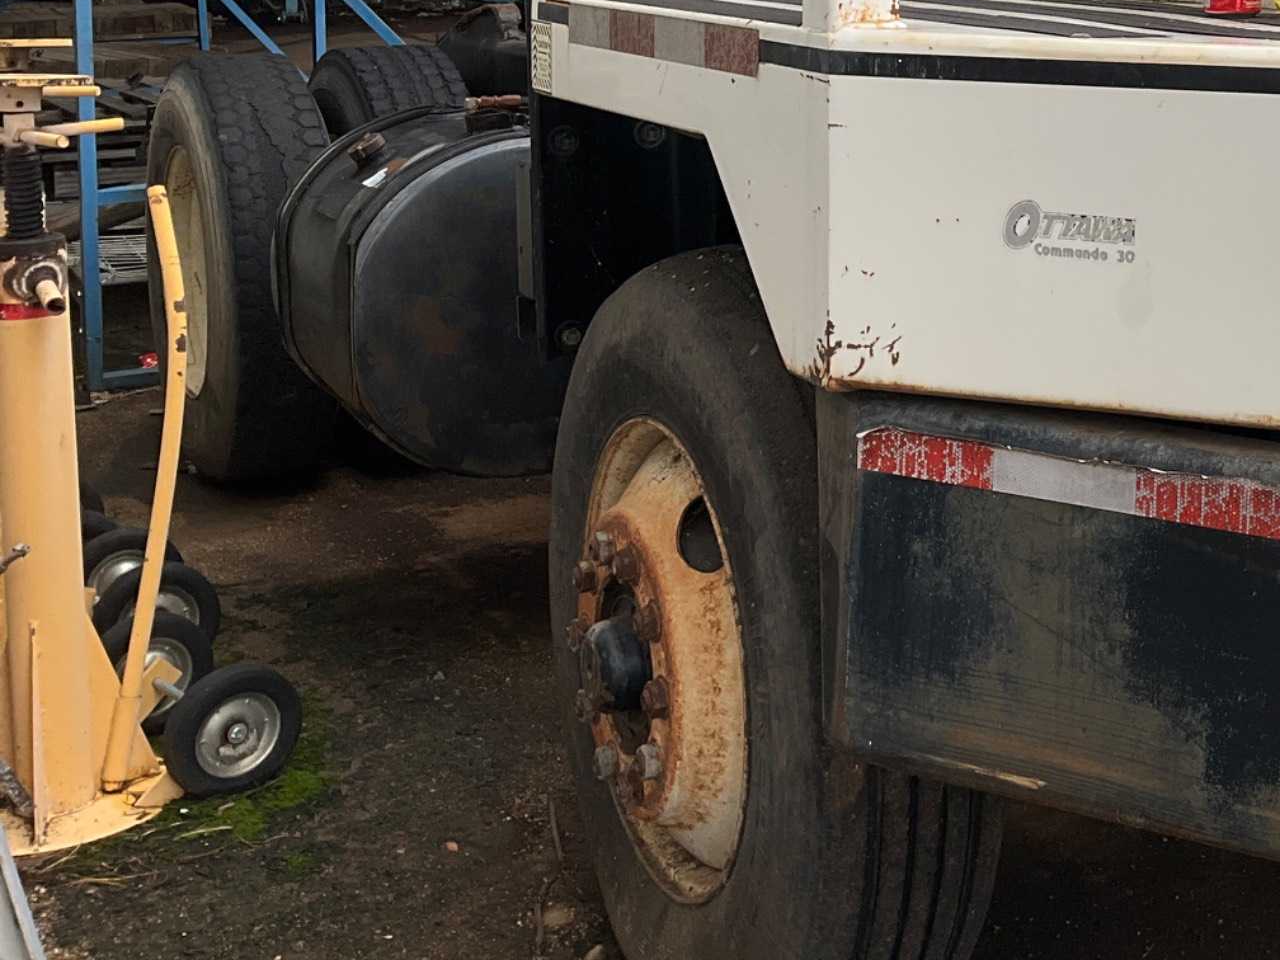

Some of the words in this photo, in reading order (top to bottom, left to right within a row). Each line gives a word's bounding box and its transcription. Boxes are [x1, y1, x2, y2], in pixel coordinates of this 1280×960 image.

[1002, 199, 1136, 250] OTTAWA
[1034, 242, 1109, 262] Commando
[1116, 249, 1136, 264] 30
